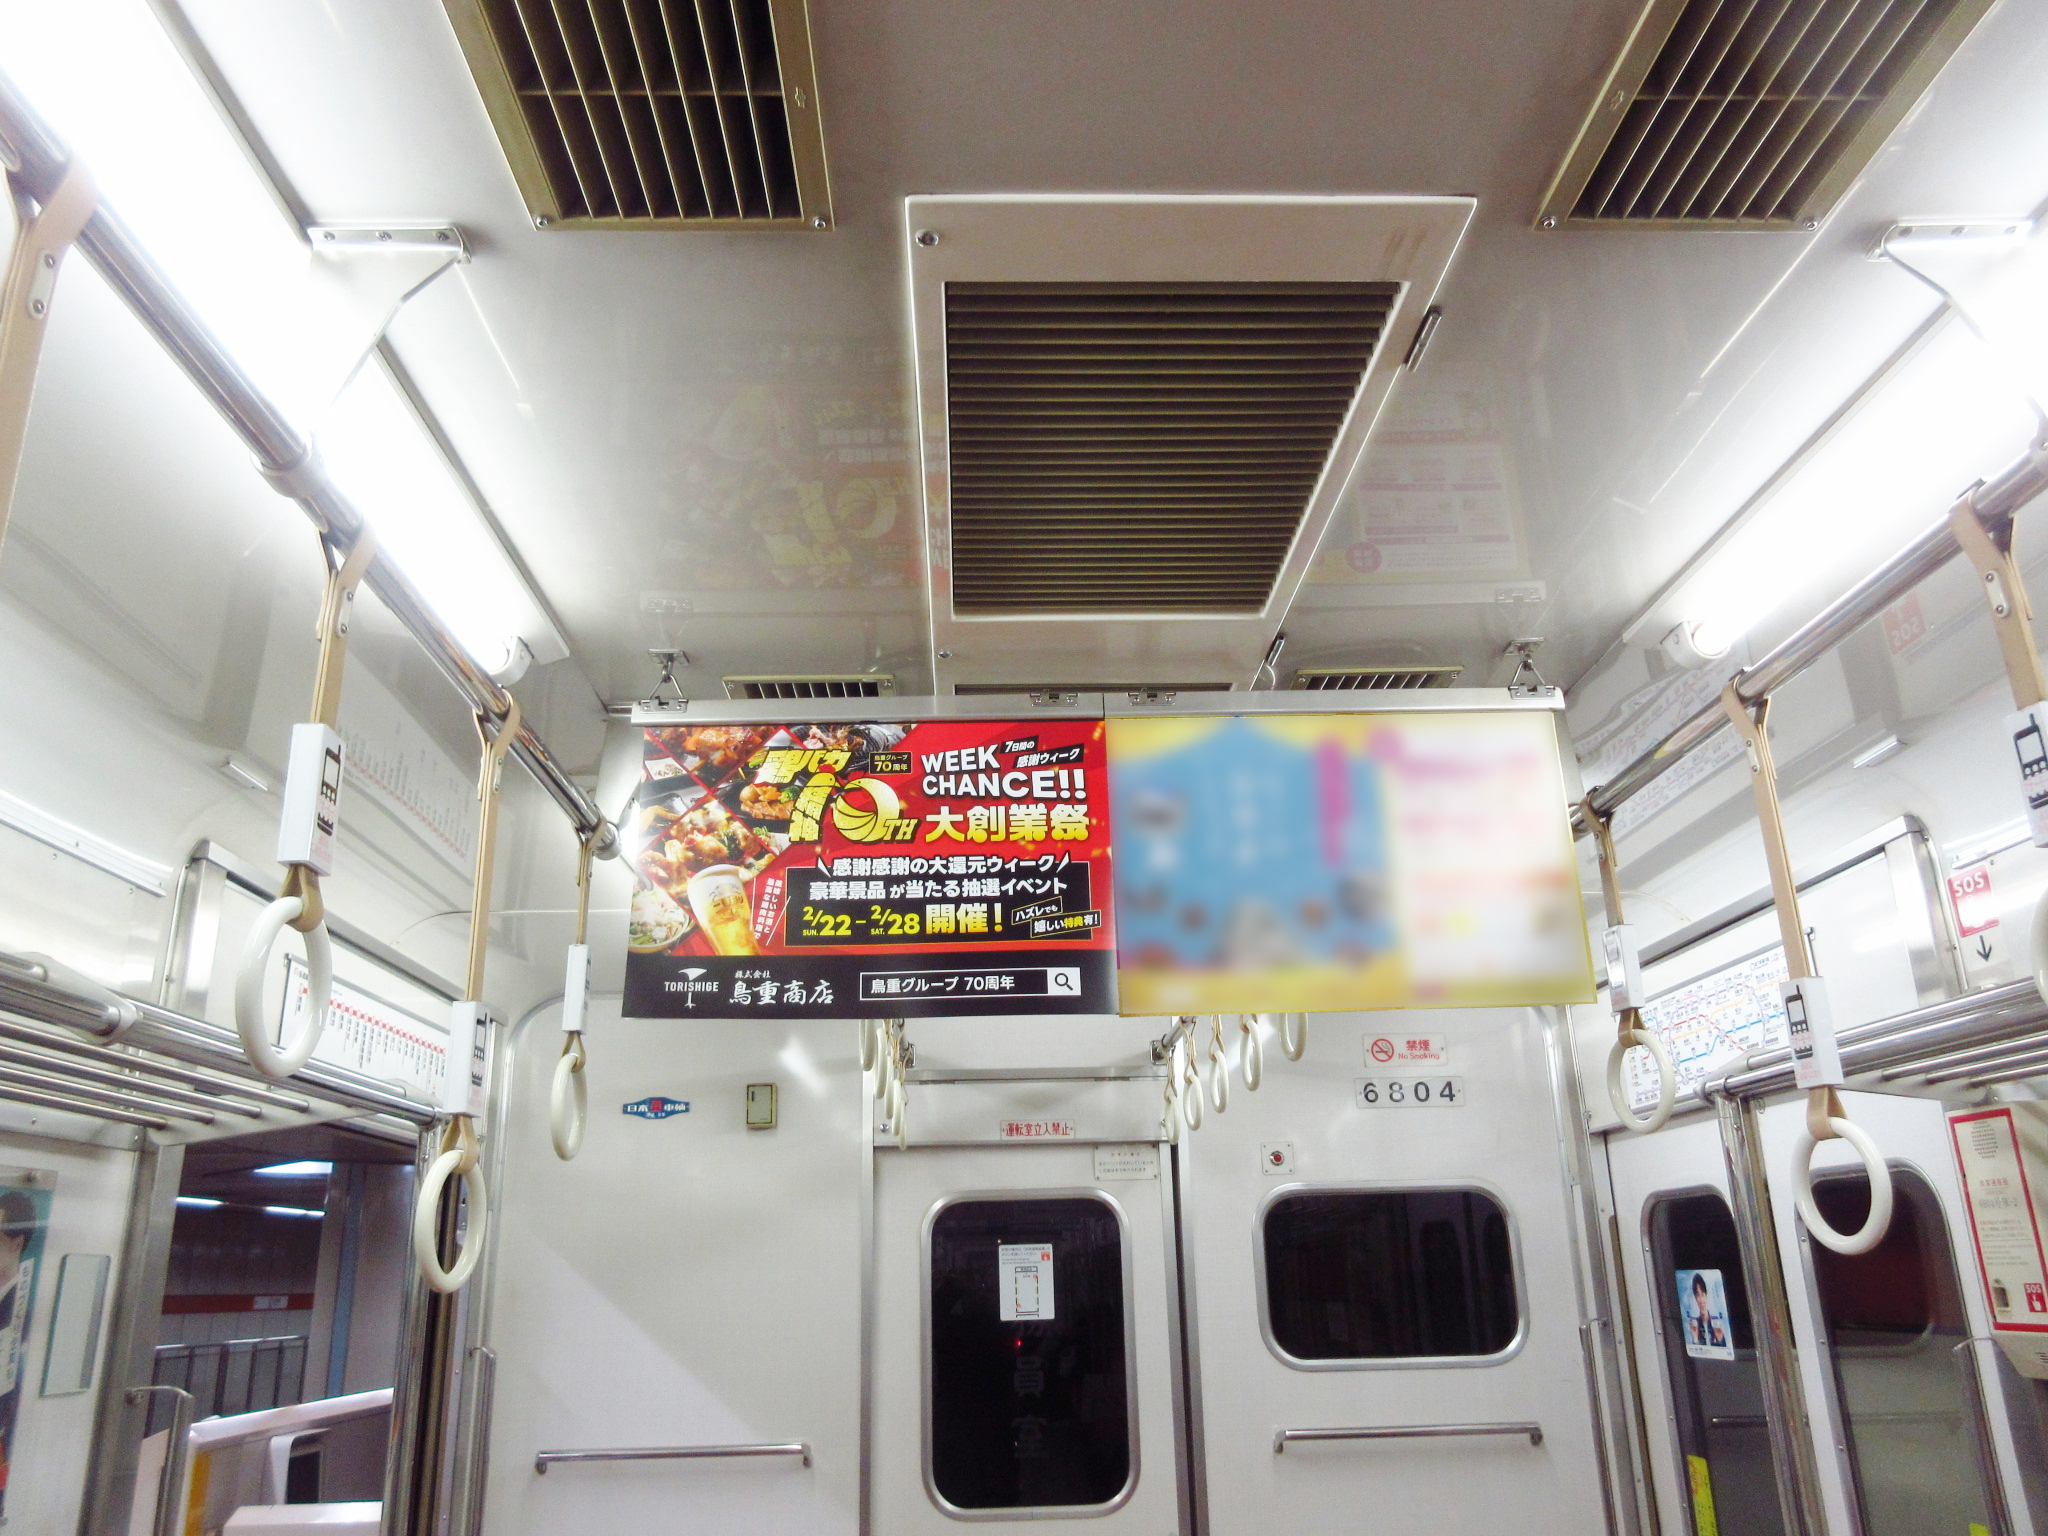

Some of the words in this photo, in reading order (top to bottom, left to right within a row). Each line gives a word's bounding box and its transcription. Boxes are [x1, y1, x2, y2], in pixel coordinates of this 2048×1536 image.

[1004, 740, 1035, 753] 7日間の
[874, 761, 908, 772] 70周年
[921, 744, 1000, 774] WEEK
[1016, 748, 1080, 769] 感謝ウィーク
[922, 768, 1087, 800] CHANCE!!
[925, 803, 1090, 843] 大創業祭
[832, 854, 1055, 877] 感謝感謝の大還元ウィーク
[1952, 871, 1985, 898] SOS
[734, 970, 771, 979] 株式会社
[664, 981, 719, 992] TORISHIGE
[729, 979, 834, 1005] 鳥重商店
[871, 976, 959, 994] 鳥重グループ
[964, 975, 1015, 991] 70周年
[1406, 1039, 1431, 1052] 禁煙
[1398, 1052, 1409, 1060] No
[1410, 1052, 1440, 1060] Smoking
[1363, 1081, 1456, 1103] 6804
[1005, 1122, 1071, 1137] 運転室立入禁止
[2025, 1284, 2042, 1294] SOS
